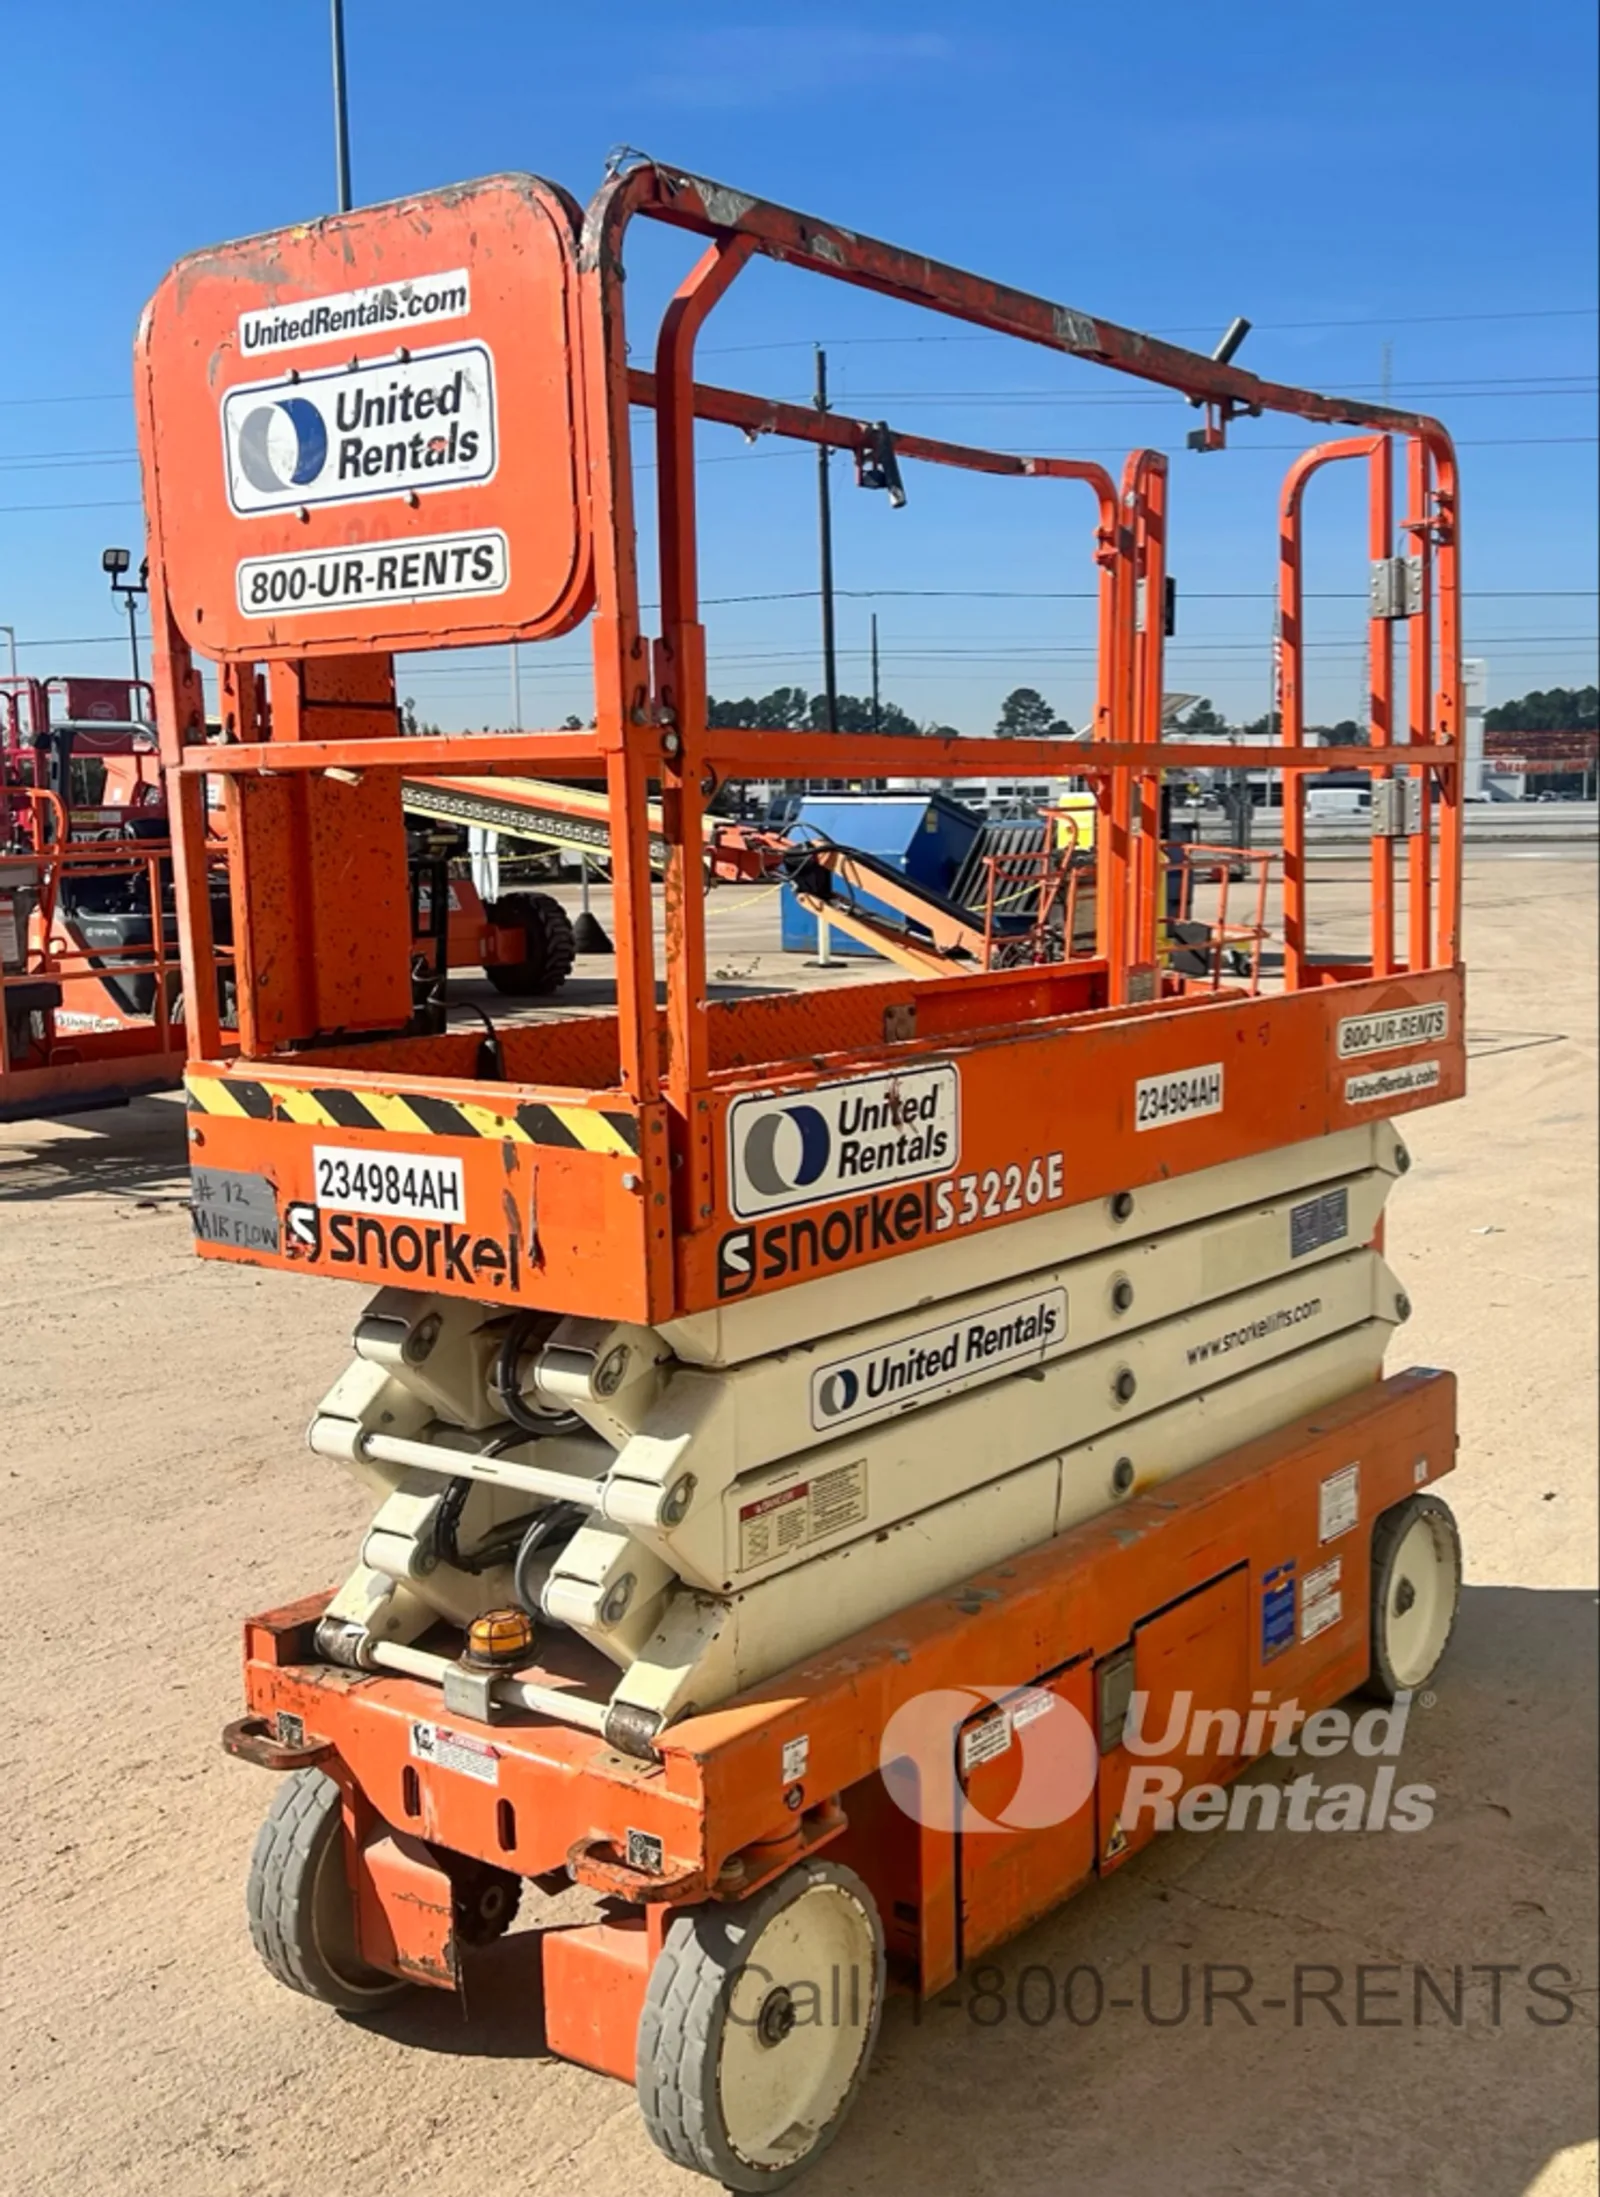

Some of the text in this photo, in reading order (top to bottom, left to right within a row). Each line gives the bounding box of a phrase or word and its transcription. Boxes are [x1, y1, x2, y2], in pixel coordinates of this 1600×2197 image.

[244, 286, 466, 348] UnitedRentals.com
[336, 371, 462, 432] United
[338, 421, 479, 479] Rentals
[250, 544, 494, 604] 800-UR-RENTS
[1343, 1010, 1444, 1049] 800-UR-RENTS
[838, 1084, 939, 1135] United
[1138, 1073, 1220, 1122] 234984AH
[837, 1124, 947, 1178] Rentals
[319, 1158, 459, 1210] 234984AH
[235, 1220, 277, 1250] FLOW
[763, 1152, 1064, 1280] snorkel S3226E
[330, 1213, 520, 1291] snorkel
[866, 1304, 1056, 1398] United Rentals
